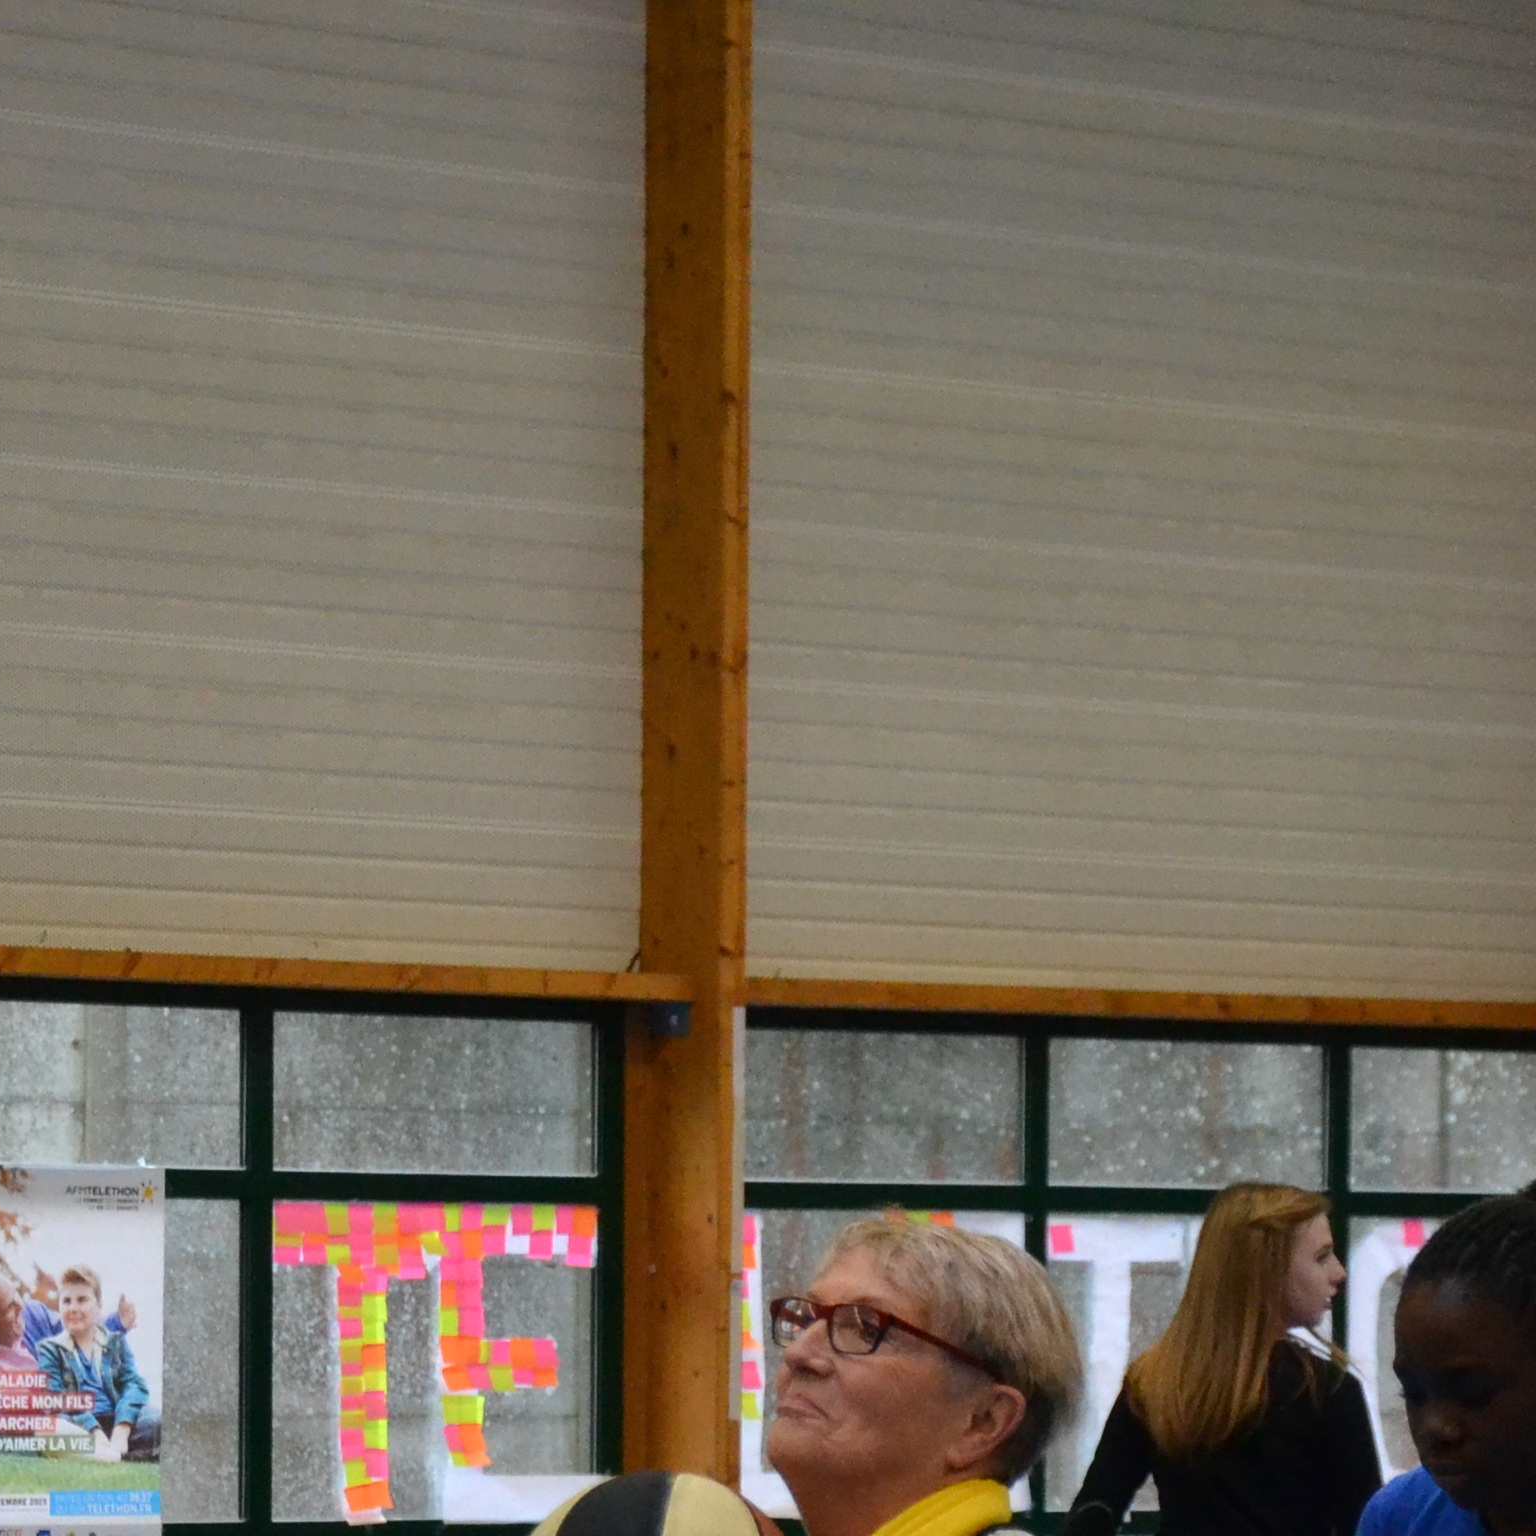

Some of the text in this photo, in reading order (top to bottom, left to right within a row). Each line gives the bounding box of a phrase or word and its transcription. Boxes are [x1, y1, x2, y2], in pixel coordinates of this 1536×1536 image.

[32, 1395, 64, 1410] MON
[66, 1396, 93, 1410] FILS
[49, 1437, 66, 1452] LA
[69, 1437, 94, 1452] VIE.
